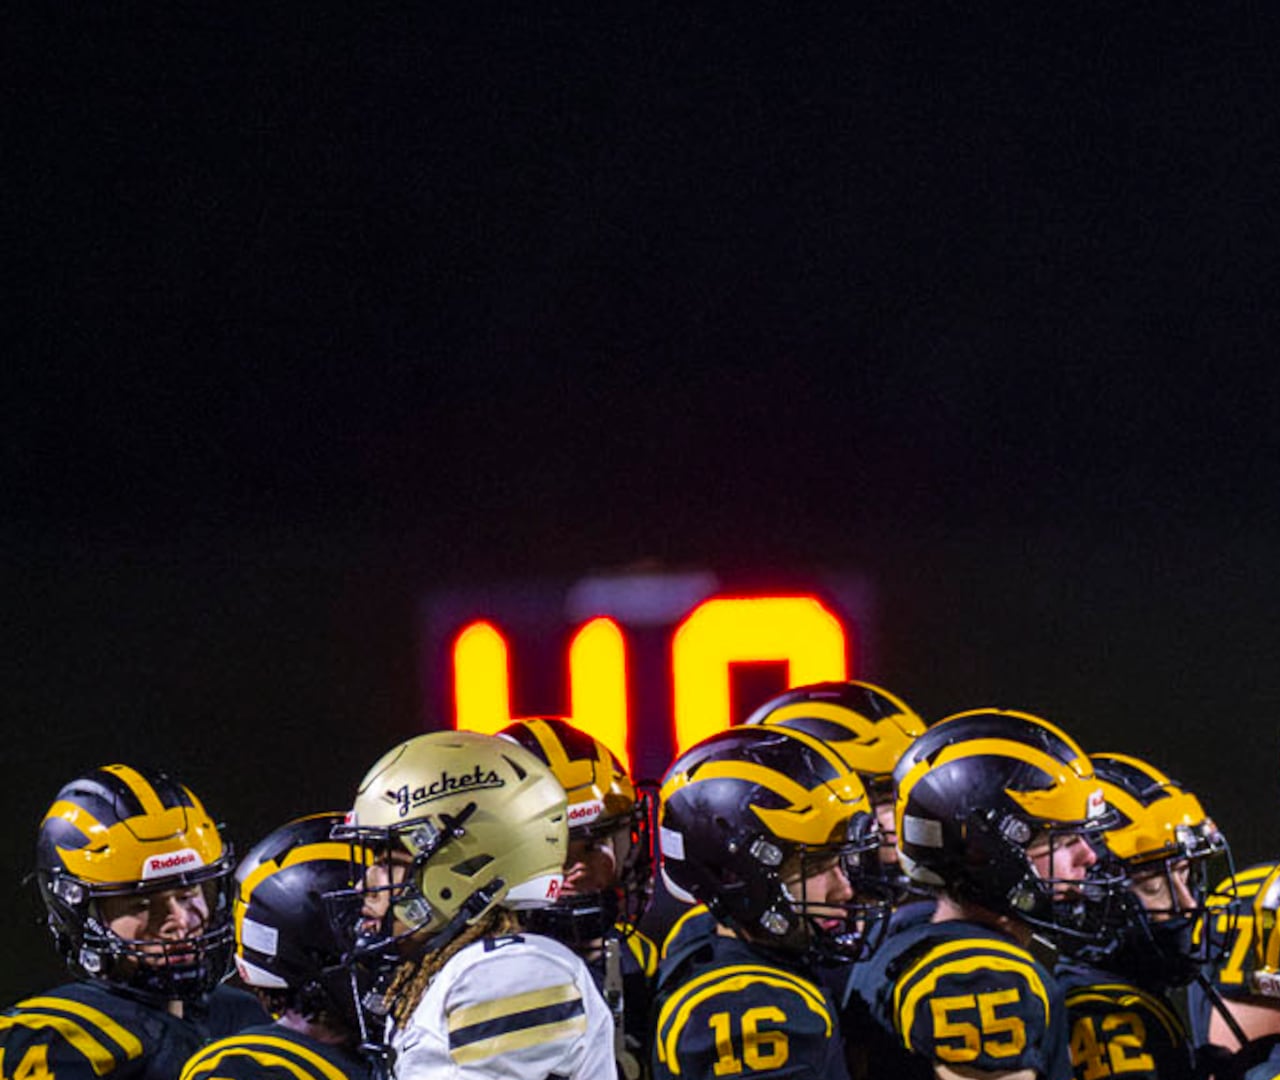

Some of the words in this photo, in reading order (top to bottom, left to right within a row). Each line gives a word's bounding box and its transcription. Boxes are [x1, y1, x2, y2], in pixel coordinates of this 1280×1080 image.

[396, 764, 506, 817] Jackets
[708, 1005, 789, 1077] 16
[929, 987, 1027, 1062] 55
